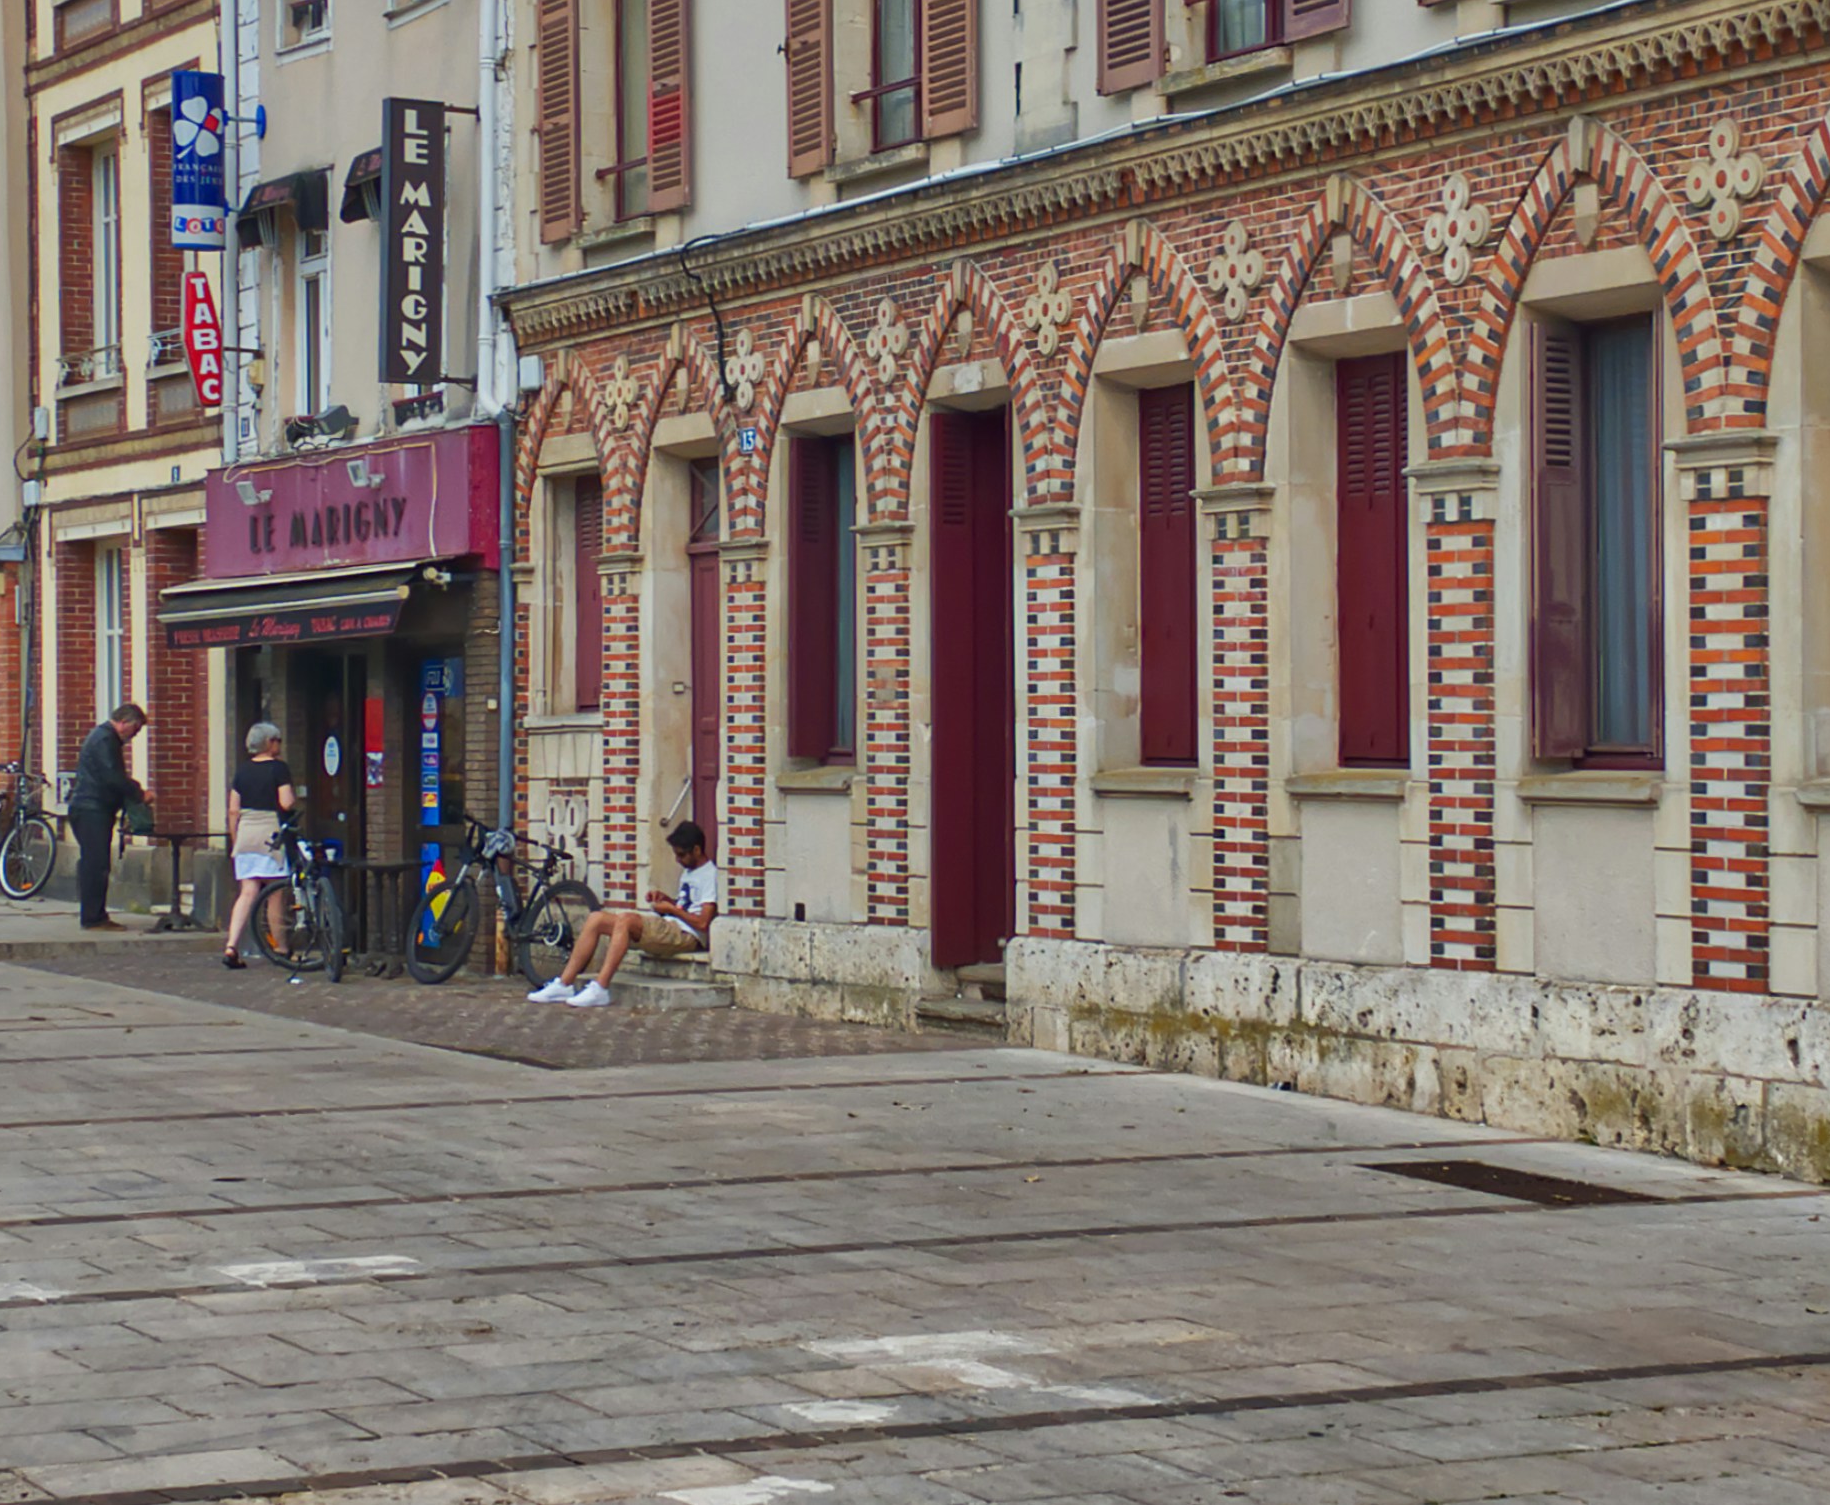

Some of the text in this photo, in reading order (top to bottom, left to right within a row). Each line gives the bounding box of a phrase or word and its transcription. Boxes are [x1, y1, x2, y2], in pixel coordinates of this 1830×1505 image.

[399, 108, 432, 375] LE MARIGNY
[190, 277, 220, 401] TABAC
[743, 430, 756, 451] 13
[250, 497, 407, 555] LE MARIGNY
